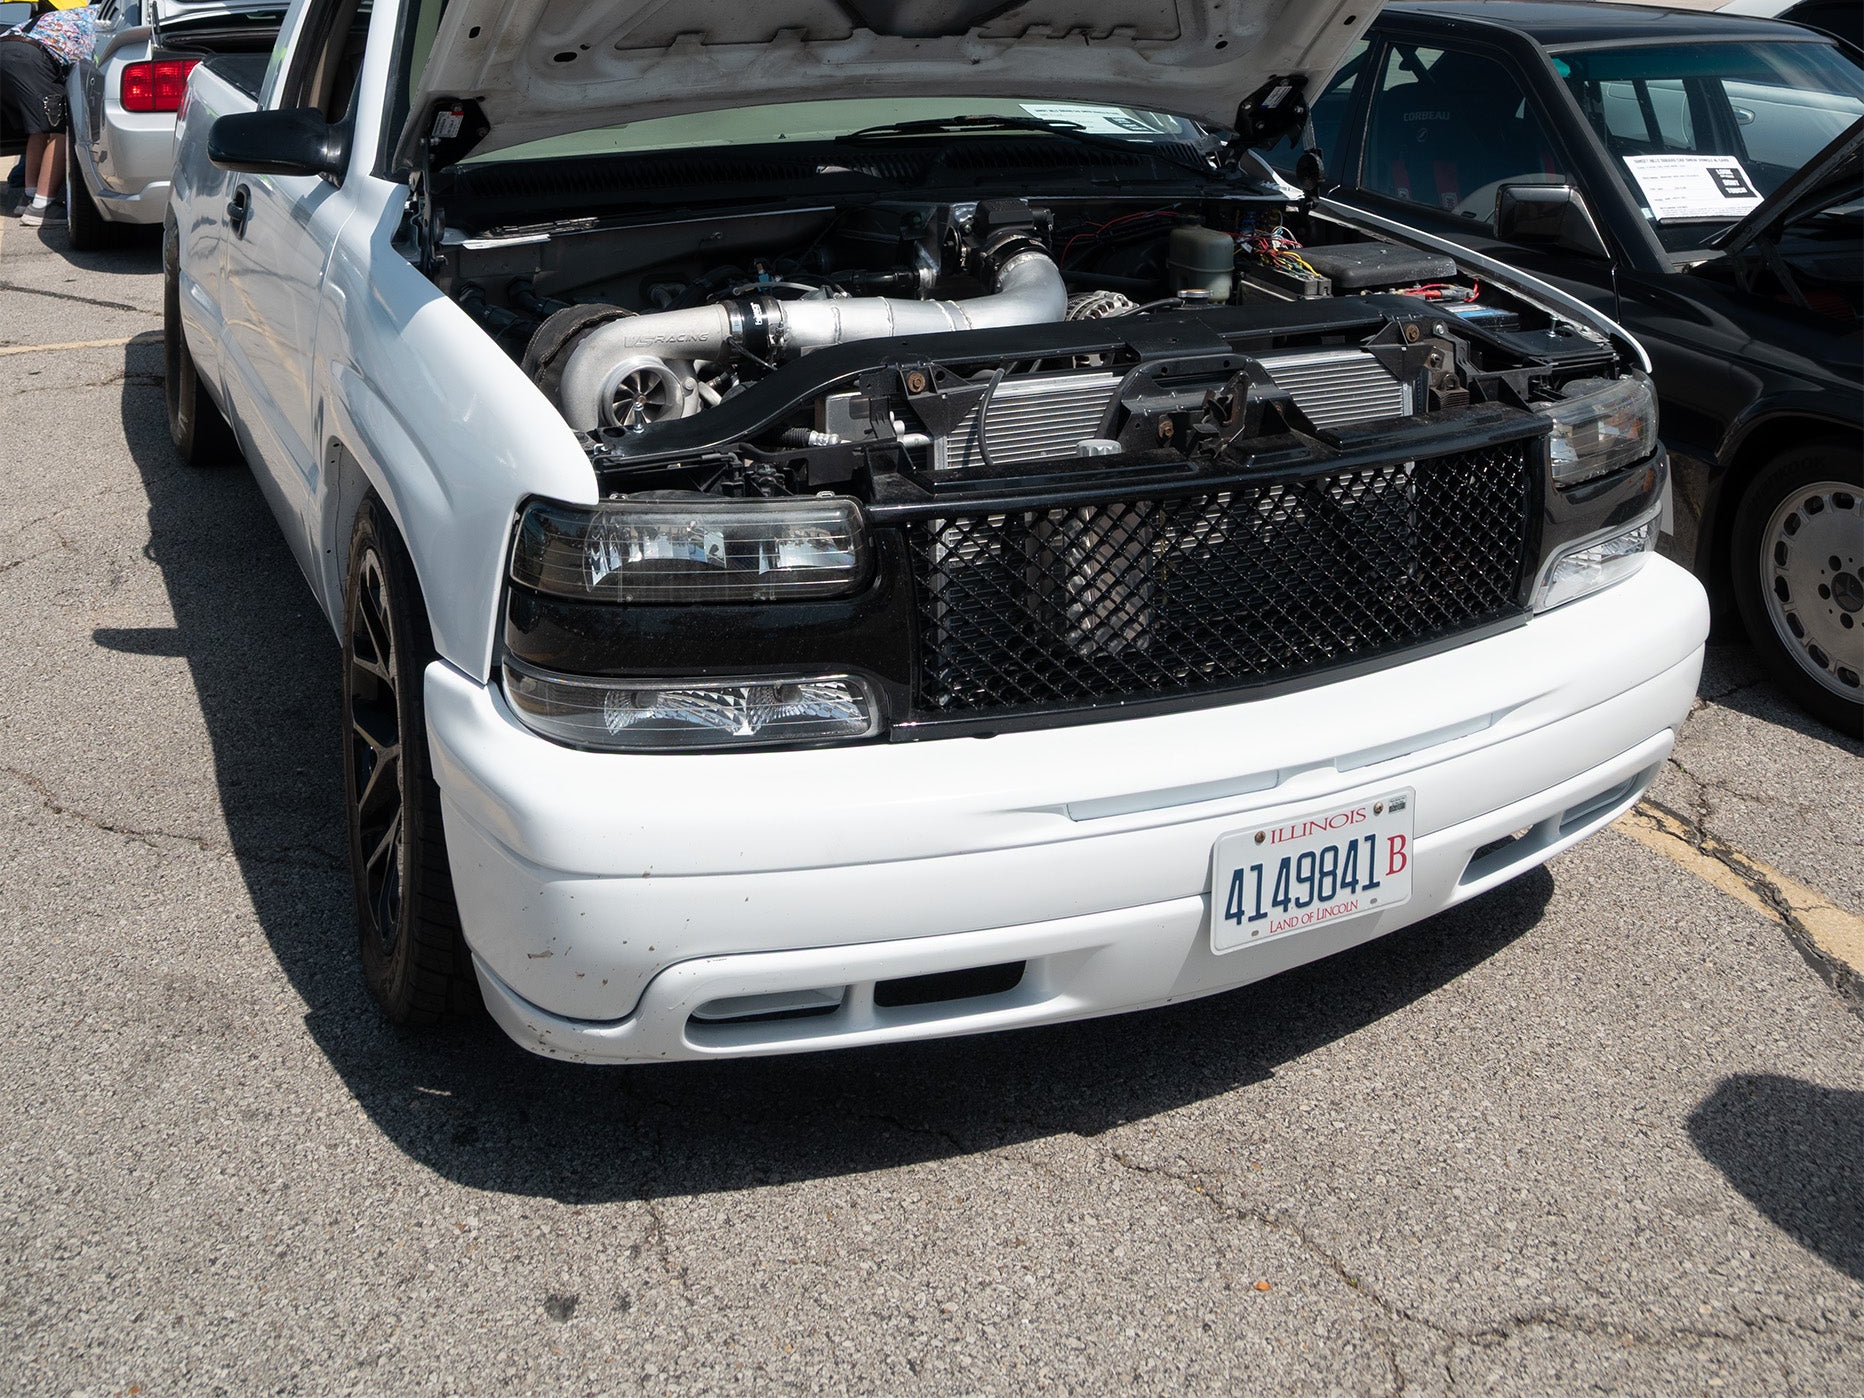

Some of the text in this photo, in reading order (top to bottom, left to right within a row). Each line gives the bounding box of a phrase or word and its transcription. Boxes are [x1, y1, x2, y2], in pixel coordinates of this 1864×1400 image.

[1403, 111, 1450, 122] CORBEAU
[654, 332, 709, 345] RACING
[1270, 807, 1367, 845] ILLINOIS
[1224, 833, 1407, 926] 4149841 B
[1269, 899, 1359, 934] LAND OF LINCOLN
